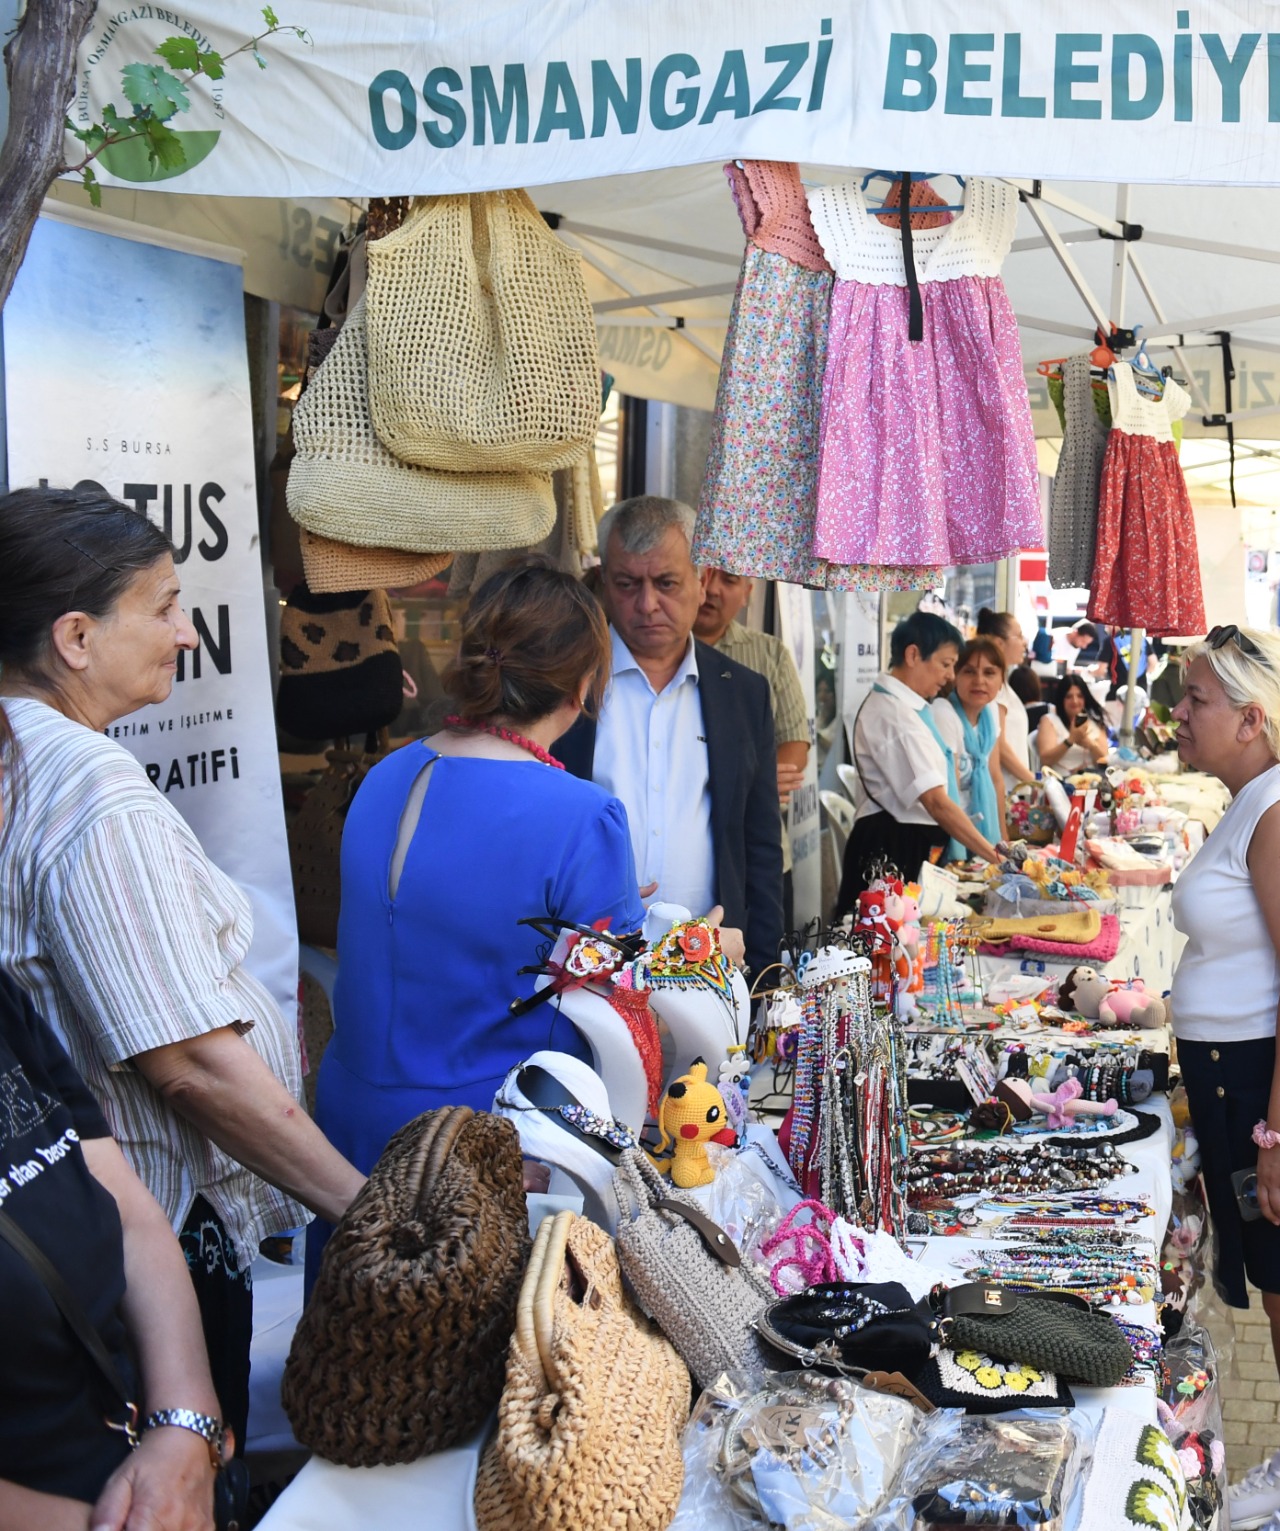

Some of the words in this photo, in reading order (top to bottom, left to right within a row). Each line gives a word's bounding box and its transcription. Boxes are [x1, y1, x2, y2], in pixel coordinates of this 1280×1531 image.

[78, 70, 92, 122] BURSA
[87, 3, 154, 65] OSMANGAZİ
[154, 6, 215, 55] BELEDİY
[212, 88, 225, 120] 1987
[368, 18, 834, 151] OSMANGAZİ
[86, 437, 109, 452] S.S
[121, 440, 171, 455] BURSA
[104, 722, 149, 739] RETİM
[158, 719, 173, 732] VE
[180, 709, 234, 729] İŞLETME
